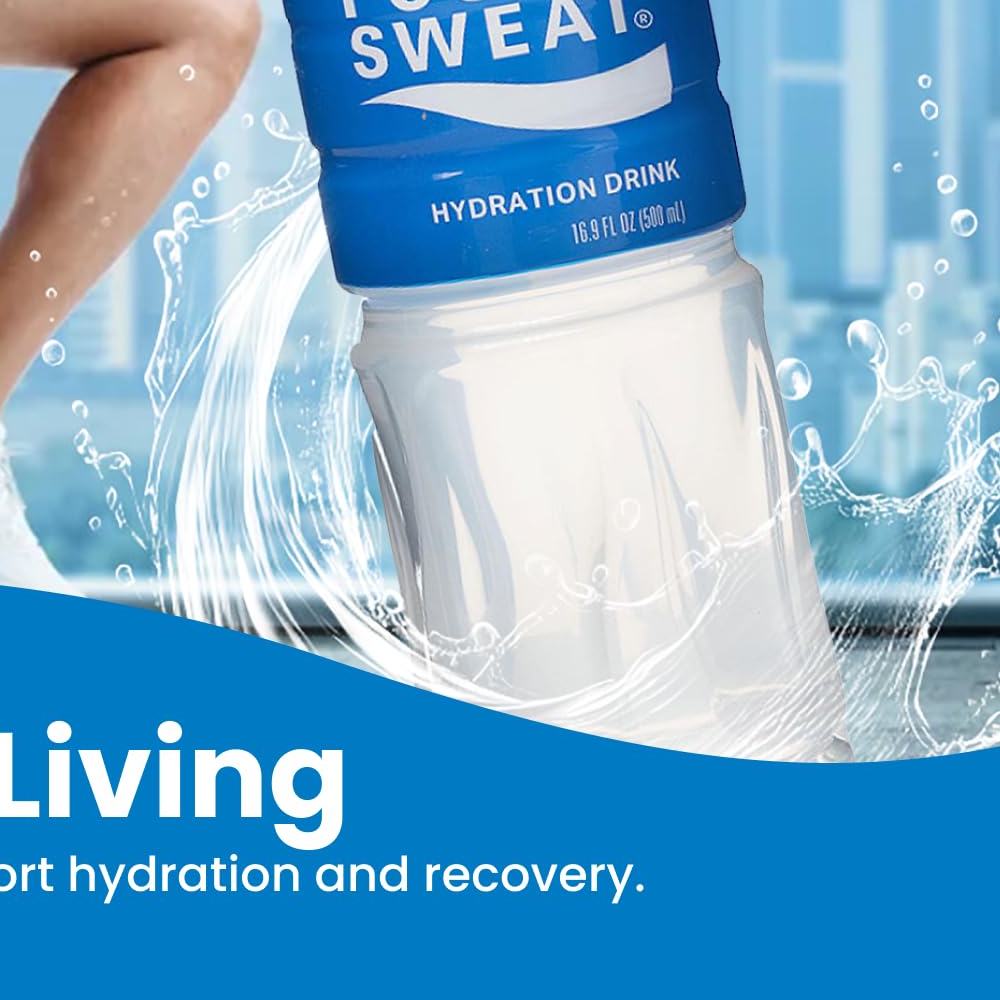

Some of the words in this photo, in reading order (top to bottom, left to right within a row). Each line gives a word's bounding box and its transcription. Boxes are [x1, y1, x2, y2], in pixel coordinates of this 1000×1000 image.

[431, 177, 597, 225] HYDRATION
[604, 158, 681, 195] DRINK
[571, 219, 600, 245] 16.9
[601, 216, 618, 239] FL
[620, 211, 637, 234] OZ
[638, 204, 665, 233] (500
